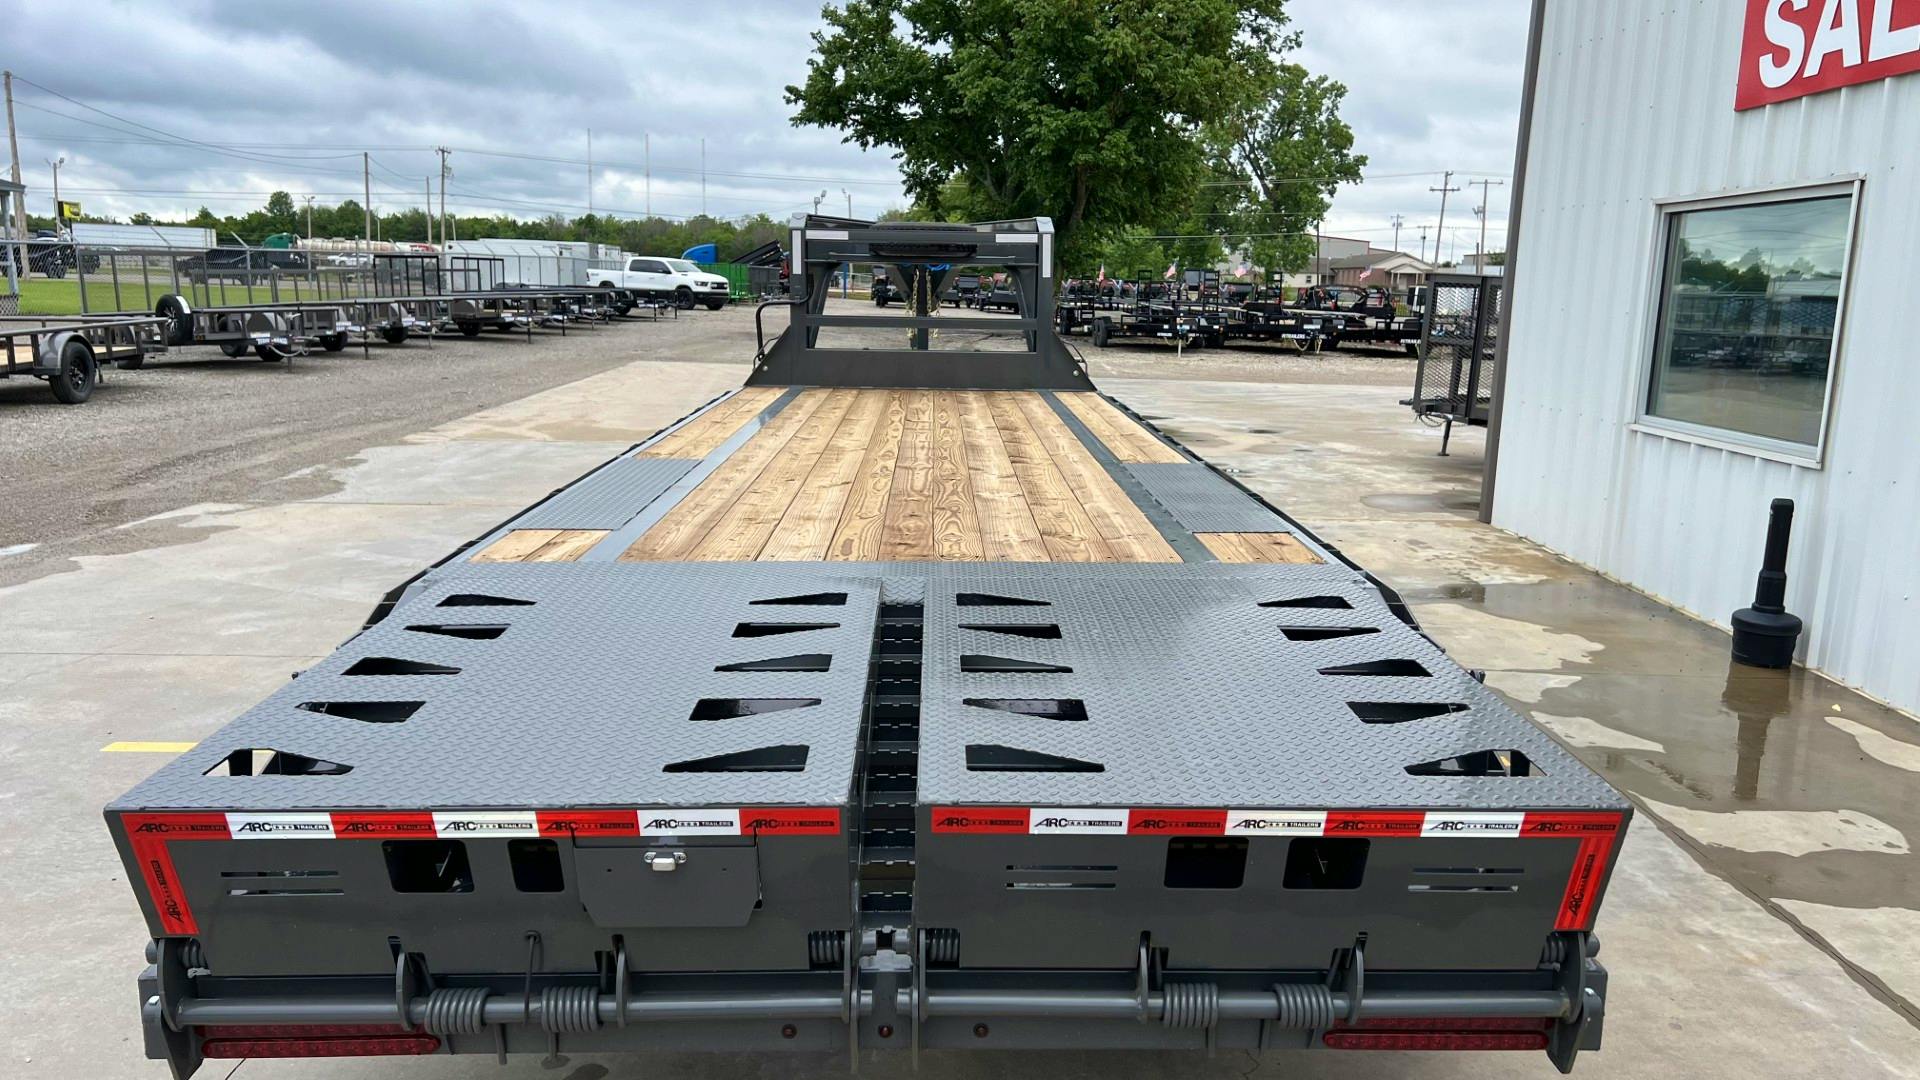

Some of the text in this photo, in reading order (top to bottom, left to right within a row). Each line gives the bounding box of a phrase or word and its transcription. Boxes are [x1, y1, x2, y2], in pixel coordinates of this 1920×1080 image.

[442, 821, 477, 831] ARC
[544, 822, 578, 831] ARC
[643, 819, 679, 828] ARC
[745, 819, 779, 828] ARC
[937, 817, 969, 827] ARC
[1034, 817, 1068, 827] ARC
[1133, 819, 1167, 829] ARC
[1233, 819, 1267, 829] ARC
[1330, 821, 1365, 830] ARC
[1429, 821, 1465, 830] ARC
[1528, 822, 1562, 831] ARC
[135, 823, 170, 832] ARC
[237, 822, 273, 832] ARC
[341, 823, 376, 832] ARC
[164, 899, 184, 924] ARC
